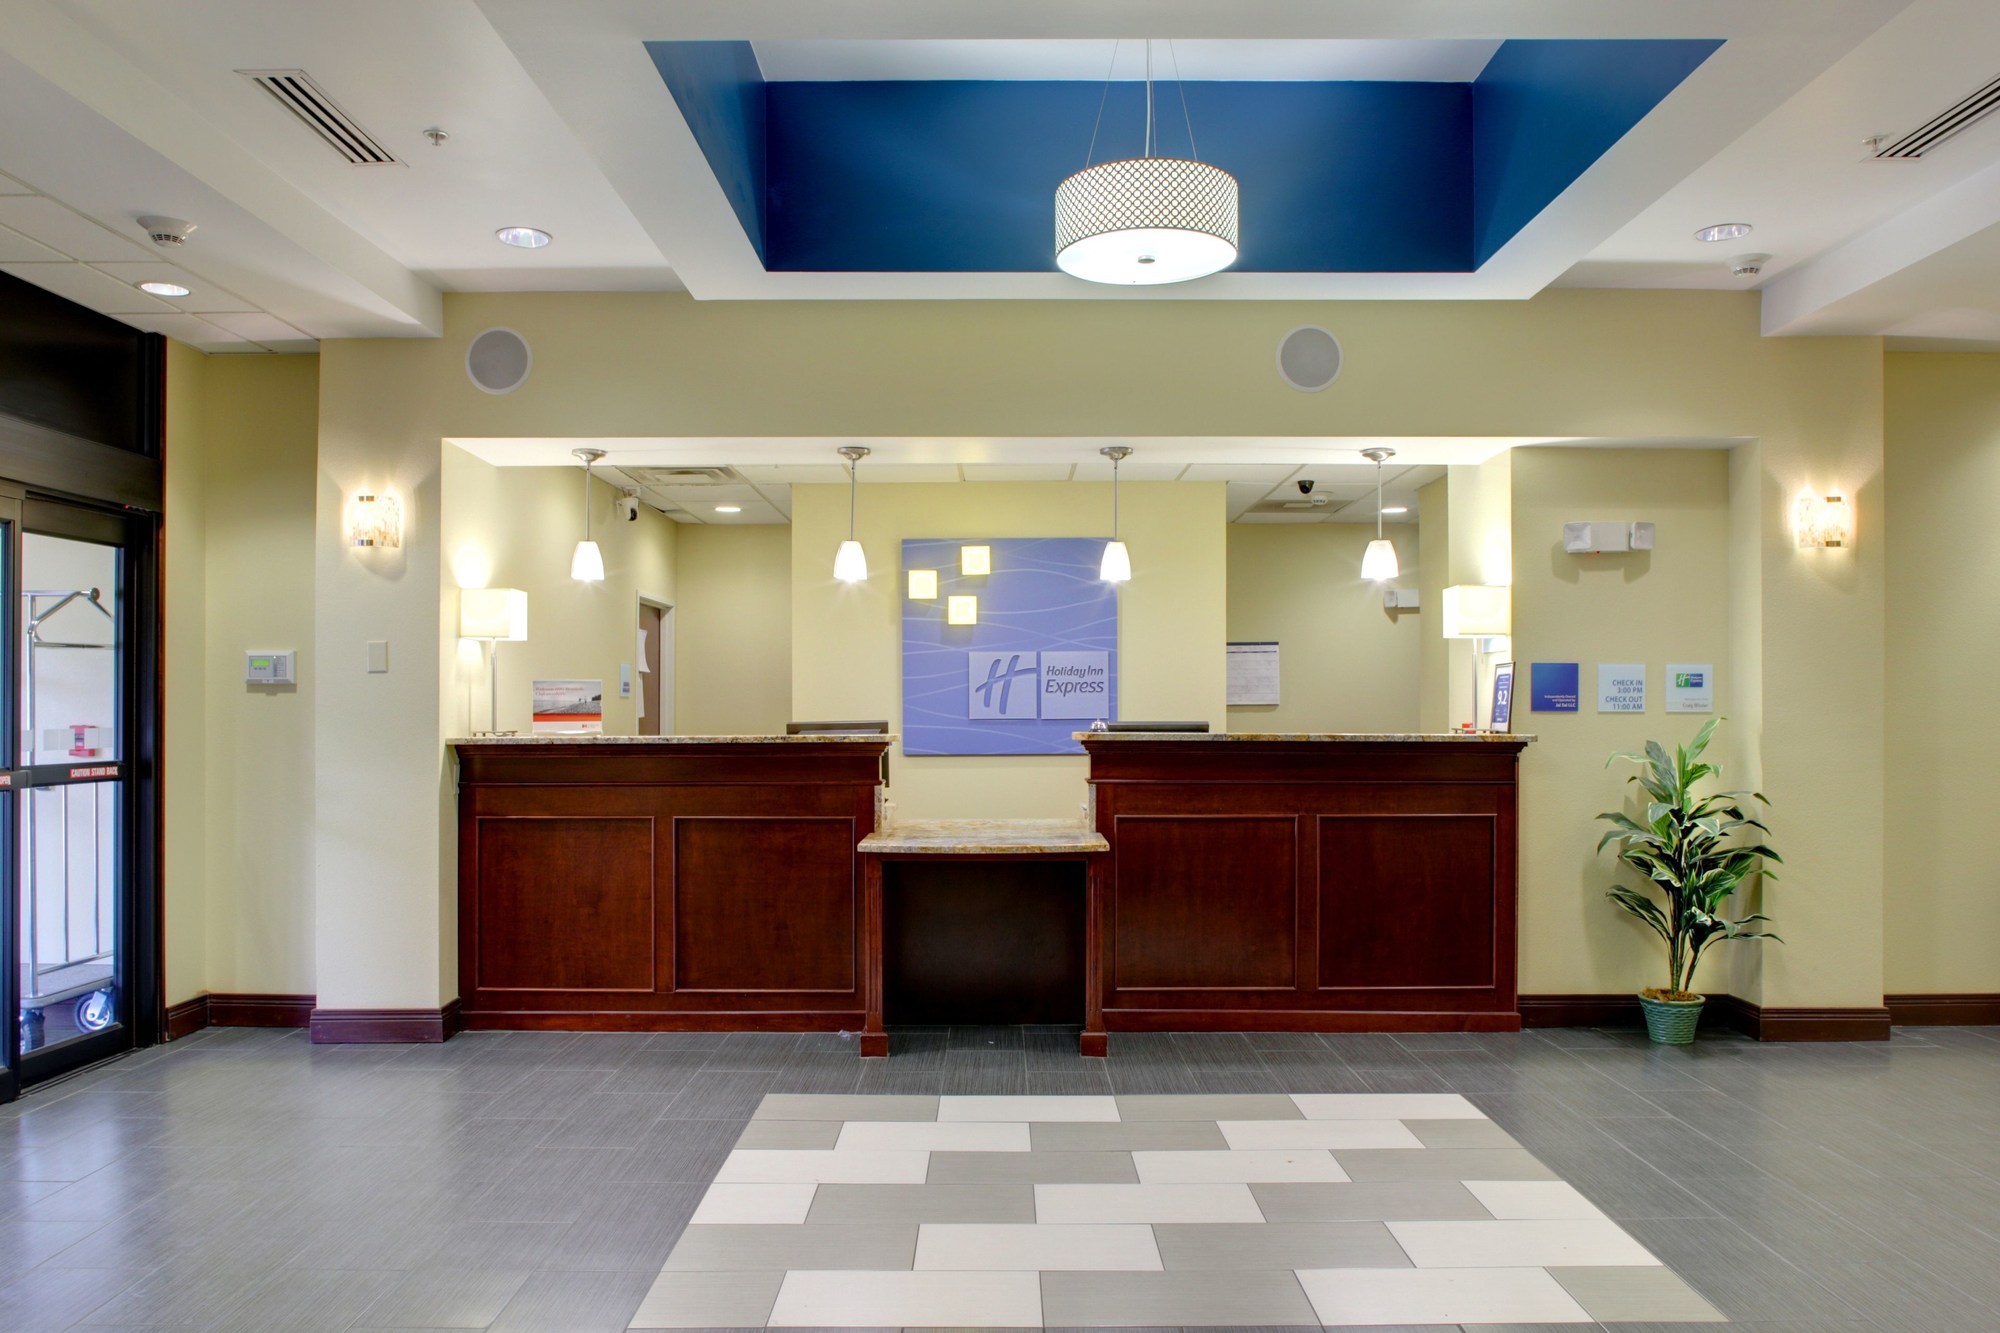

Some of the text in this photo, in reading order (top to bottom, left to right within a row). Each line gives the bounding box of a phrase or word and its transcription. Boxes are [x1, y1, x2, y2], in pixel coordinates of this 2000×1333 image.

[1046, 665, 1104, 678] Holiday Inn
[1045, 679, 1104, 697] Express
[1612, 679, 1643, 687] CHECK IN
[1617, 686, 1643, 694] 3:00 PM
[1605, 695, 1643, 703] CHECK OUT
[71, 766, 118, 778] CAUTION STAND BACK
